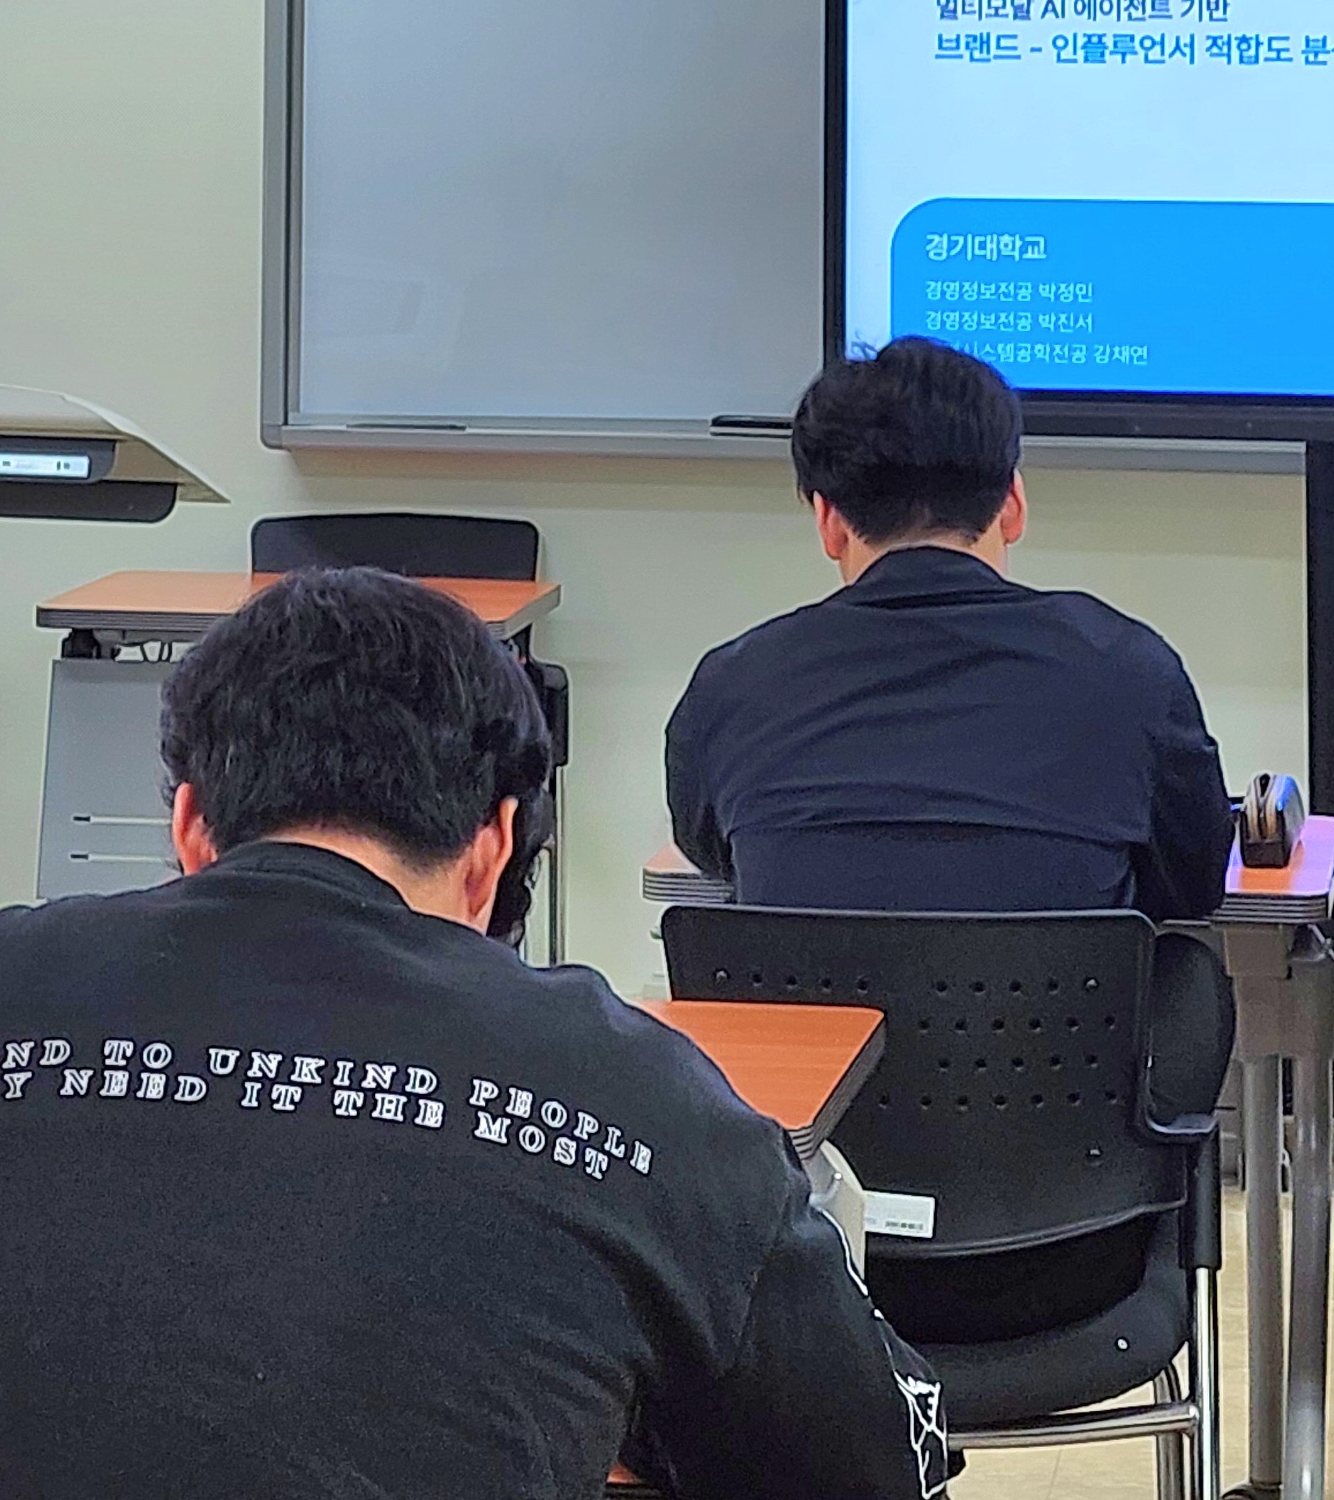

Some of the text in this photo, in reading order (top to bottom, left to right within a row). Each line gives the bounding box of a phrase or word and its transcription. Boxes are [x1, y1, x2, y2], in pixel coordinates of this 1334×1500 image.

[934, 32, 1022, 63] 브랜드
[1051, 32, 1197, 65] 인플루언서
[1205, 33, 1294, 65] 적합도
[925, 232, 1047, 262] 경기대학교
[925, 280, 1094, 303] 경영정보전공 박정민
[925, 310, 1094, 333] 경영정보전공 박진서
[951, 341, 1149, 366] 시스템공학전공 강채연
[104, 1040, 171, 1069] TO
[208, 1048, 438, 1095] UNKIND
[469, 1079, 652, 1175] PEOPLE
[59, 1069, 207, 1102] NEED
[241, 1082, 301, 1111] IT
[334, 1089, 445, 1130] THE
[474, 1111, 609, 1181] MOST
